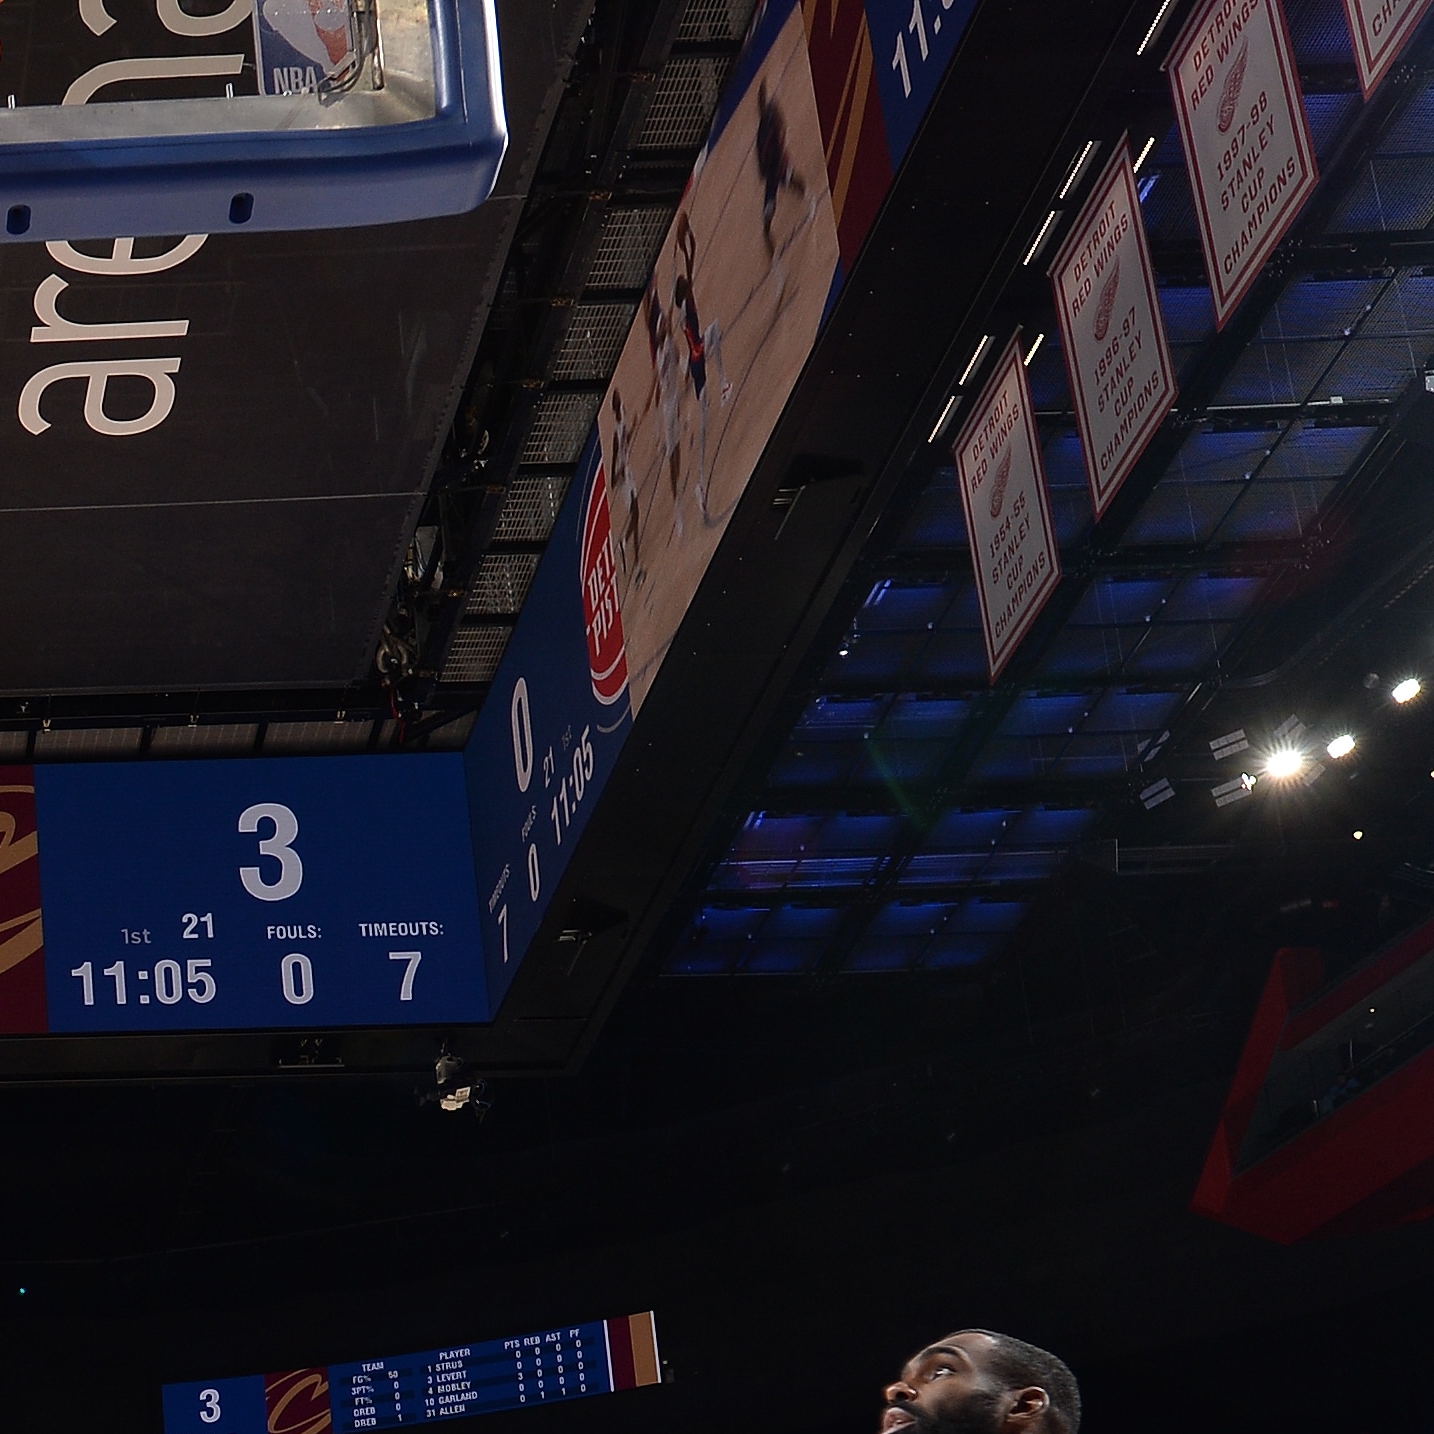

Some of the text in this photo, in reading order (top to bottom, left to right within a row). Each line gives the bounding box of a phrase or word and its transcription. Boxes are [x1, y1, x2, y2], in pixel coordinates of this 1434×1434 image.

[273, 65, 318, 96] NBA
[1190, 0, 1258, 111] RED WINGS
[1216, 91, 1268, 181] 1997-98
[1220, 114, 1275, 211] STANLEY
[1224, 156, 1296, 275] CHAMPIONS
[1241, 167, 1265, 214] CUP
[1072, 213, 1129, 318] RED WINGS
[1073, 200, 1117, 284] DETROIT
[1093, 305, 1138, 387] 1996-97
[1097, 330, 1144, 414] STANLEY
[972, 390, 1009, 461] DETROIT
[1100, 370, 1160, 472] CHAMPIONS
[1114, 376, 1135, 418] CUP
[971, 403, 1020, 494] RED WINGS
[989, 490, 1027, 559] 1954-55
[992, 512, 1033, 585] STANLEY
[995, 551, 1046, 639] CHAMPIONS
[1006, 554, 1025, 590] CUP
[551, 725, 594, 846] 11:05
[237, 802, 305, 901] 3
[120, 912, 216, 946] 1st 21
[266, 920, 445, 941] FOULS: TIMEOUTS:
[70, 957, 217, 1006] 11:05
[280, 951, 423, 1005] 0 7
[435, 1360, 463, 1372] STRUS
[436, 1370, 467, 1383] LEVERT
[437, 1381, 471, 1394] MOBLEY
[439, 1348, 471, 1360] PLAYER
[199, 1388, 221, 1423] 3
[438, 1391, 478, 1405] GARLAND
[439, 1403, 466, 1416] ALLEN
